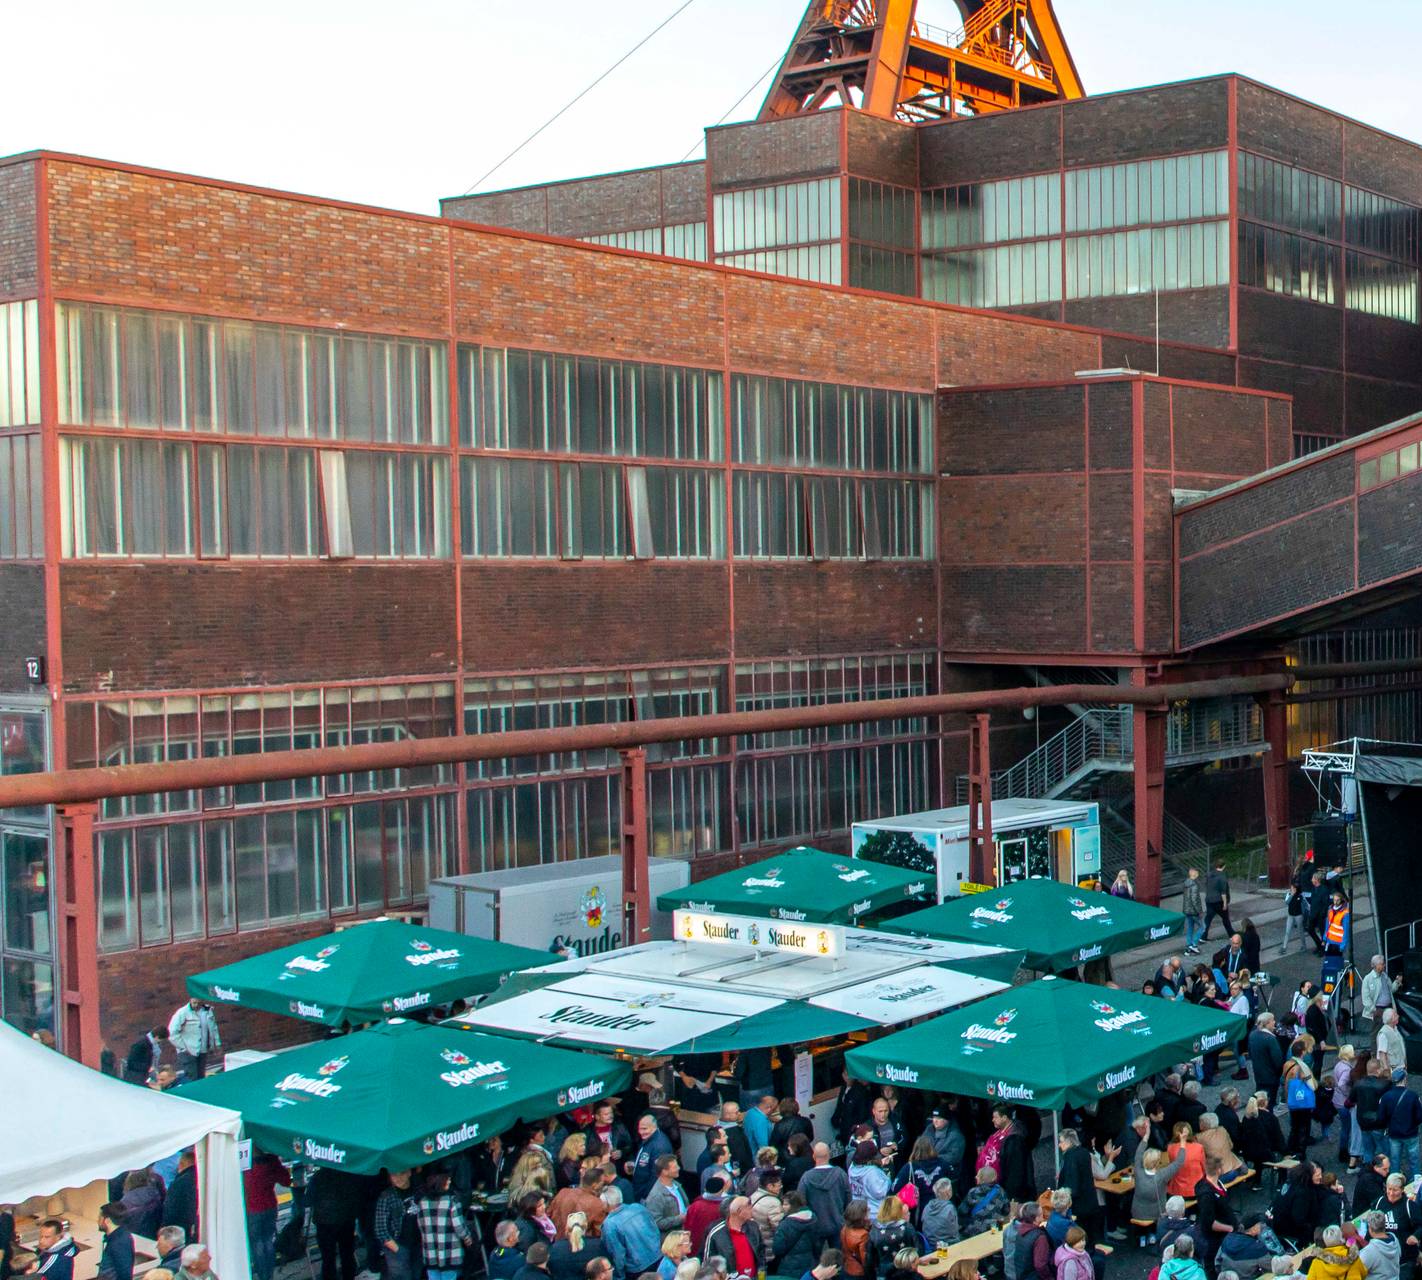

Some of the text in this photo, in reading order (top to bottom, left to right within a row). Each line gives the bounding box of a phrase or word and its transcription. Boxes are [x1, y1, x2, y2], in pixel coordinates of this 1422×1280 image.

[27, 662, 39, 678] 12
[778, 907, 807, 922] Stauder
[553, 926, 621, 957] aude
[703, 920, 806, 948] Stauder Stauder
[405, 948, 460, 967] Stauder
[1078, 944, 1102, 961] Stauder
[393, 991, 431, 1012] Stauder
[538, 1004, 656, 1031] Stauder
[1094, 1009, 1149, 1032] Stauder
[960, 1023, 1017, 1044] Stauder
[1201, 1029, 1228, 1051] Stauder
[440, 1059, 508, 1087] Stauder
[885, 1063, 919, 1083] Stauder
[1105, 1065, 1136, 1090] Stauder
[274, 1072, 342, 1098] Stauder
[568, 1079, 604, 1104] Stauder
[997, 1081, 1034, 1100] Stauder
[436, 1122, 479, 1151] Stauder
[304, 1138, 346, 1163] Stauder
